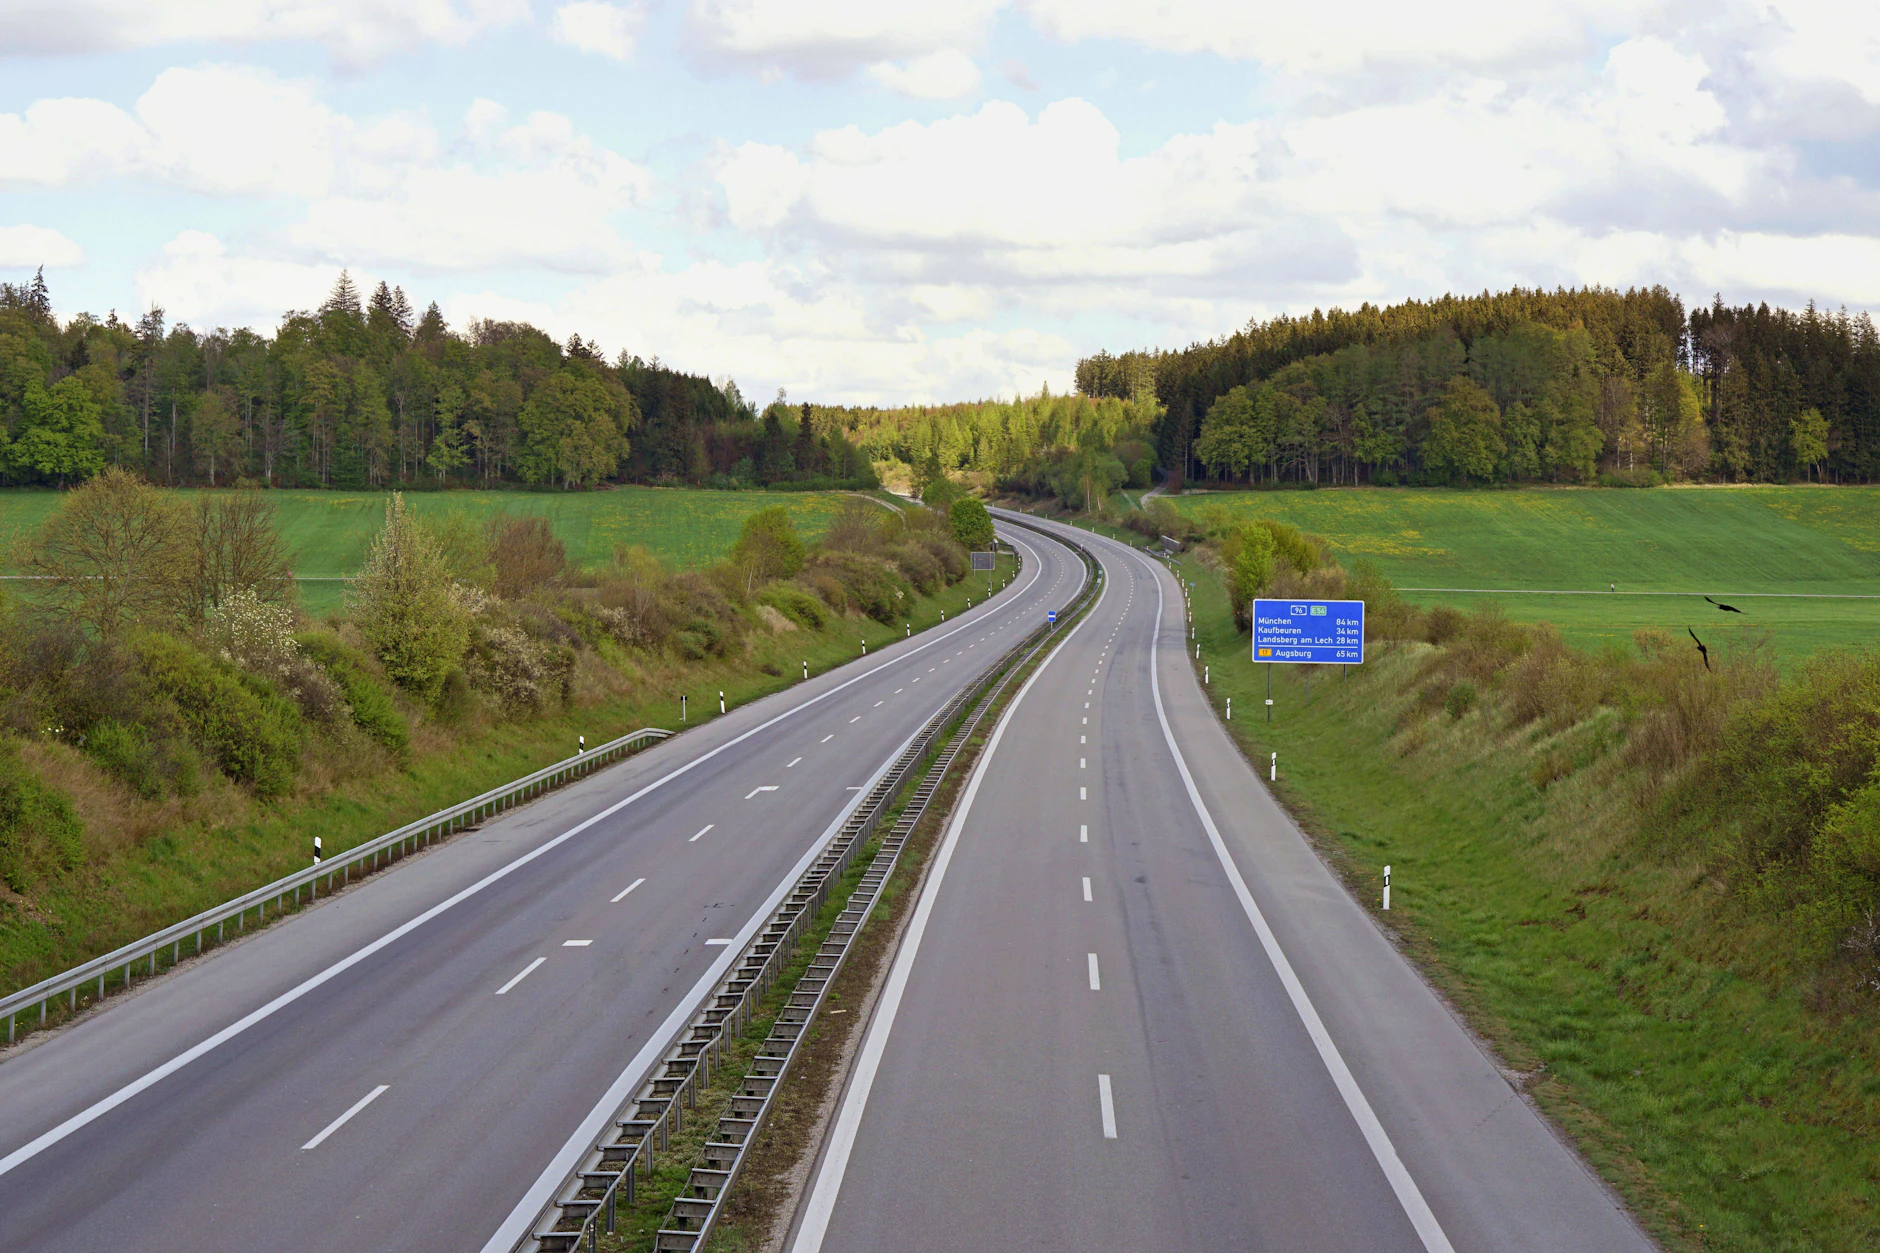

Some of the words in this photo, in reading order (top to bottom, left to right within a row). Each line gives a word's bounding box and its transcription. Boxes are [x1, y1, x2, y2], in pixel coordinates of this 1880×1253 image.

[1258, 617, 1292, 625] München
[1336, 618, 1346, 626] 84
[1347, 618, 1359, 626] km
[1258, 626, 1301, 634] Kaufbeuren
[1258, 636, 1298, 645] Landsberg
[1346, 637, 1359, 645] km
[1275, 649, 1312, 658] Augsburg
[1336, 650, 1345, 658] 65
[1346, 650, 1359, 658] km
